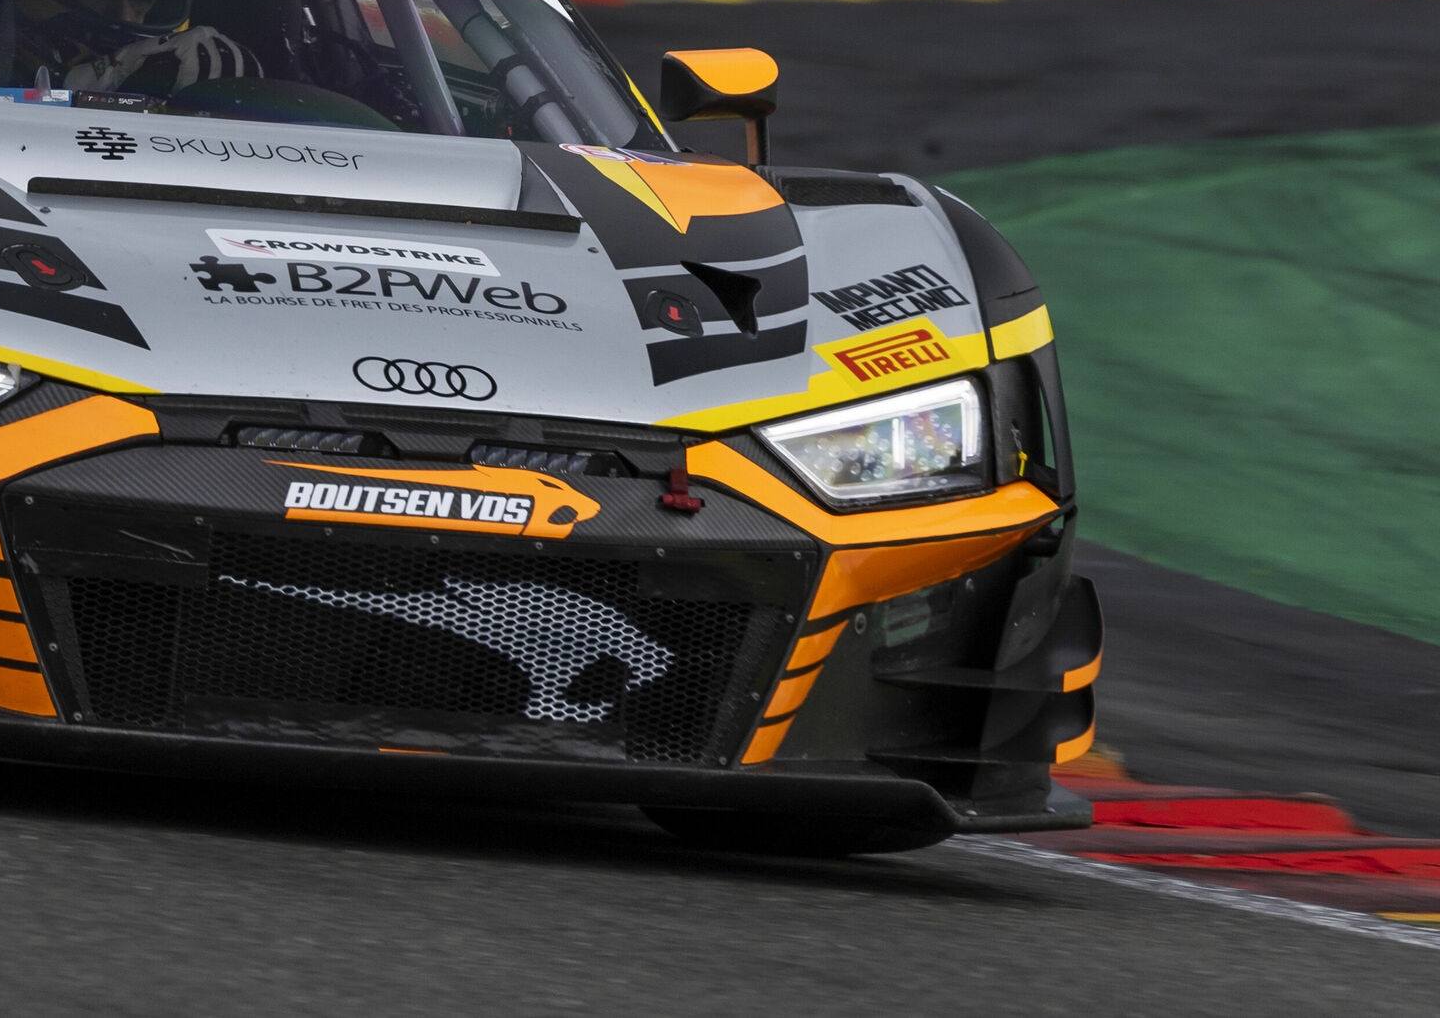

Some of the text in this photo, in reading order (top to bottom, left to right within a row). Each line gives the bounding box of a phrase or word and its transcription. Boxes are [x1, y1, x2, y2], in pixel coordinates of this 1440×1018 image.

[149, 136, 364, 170] skywater
[243, 239, 486, 267] CROWDSTRIKE
[287, 262, 568, 315] B2PWeb
[810, 264, 950, 314] IMPIANTI
[236, 295, 309, 307] BOURSE
[312, 297, 337, 308] DE
[341, 299, 383, 310] FRET
[388, 301, 424, 313] DES
[427, 304, 584, 333] PROFESSIONNELS
[833, 329, 951, 382] PIRELLI
[284, 481, 455, 518] BOUTSEN
